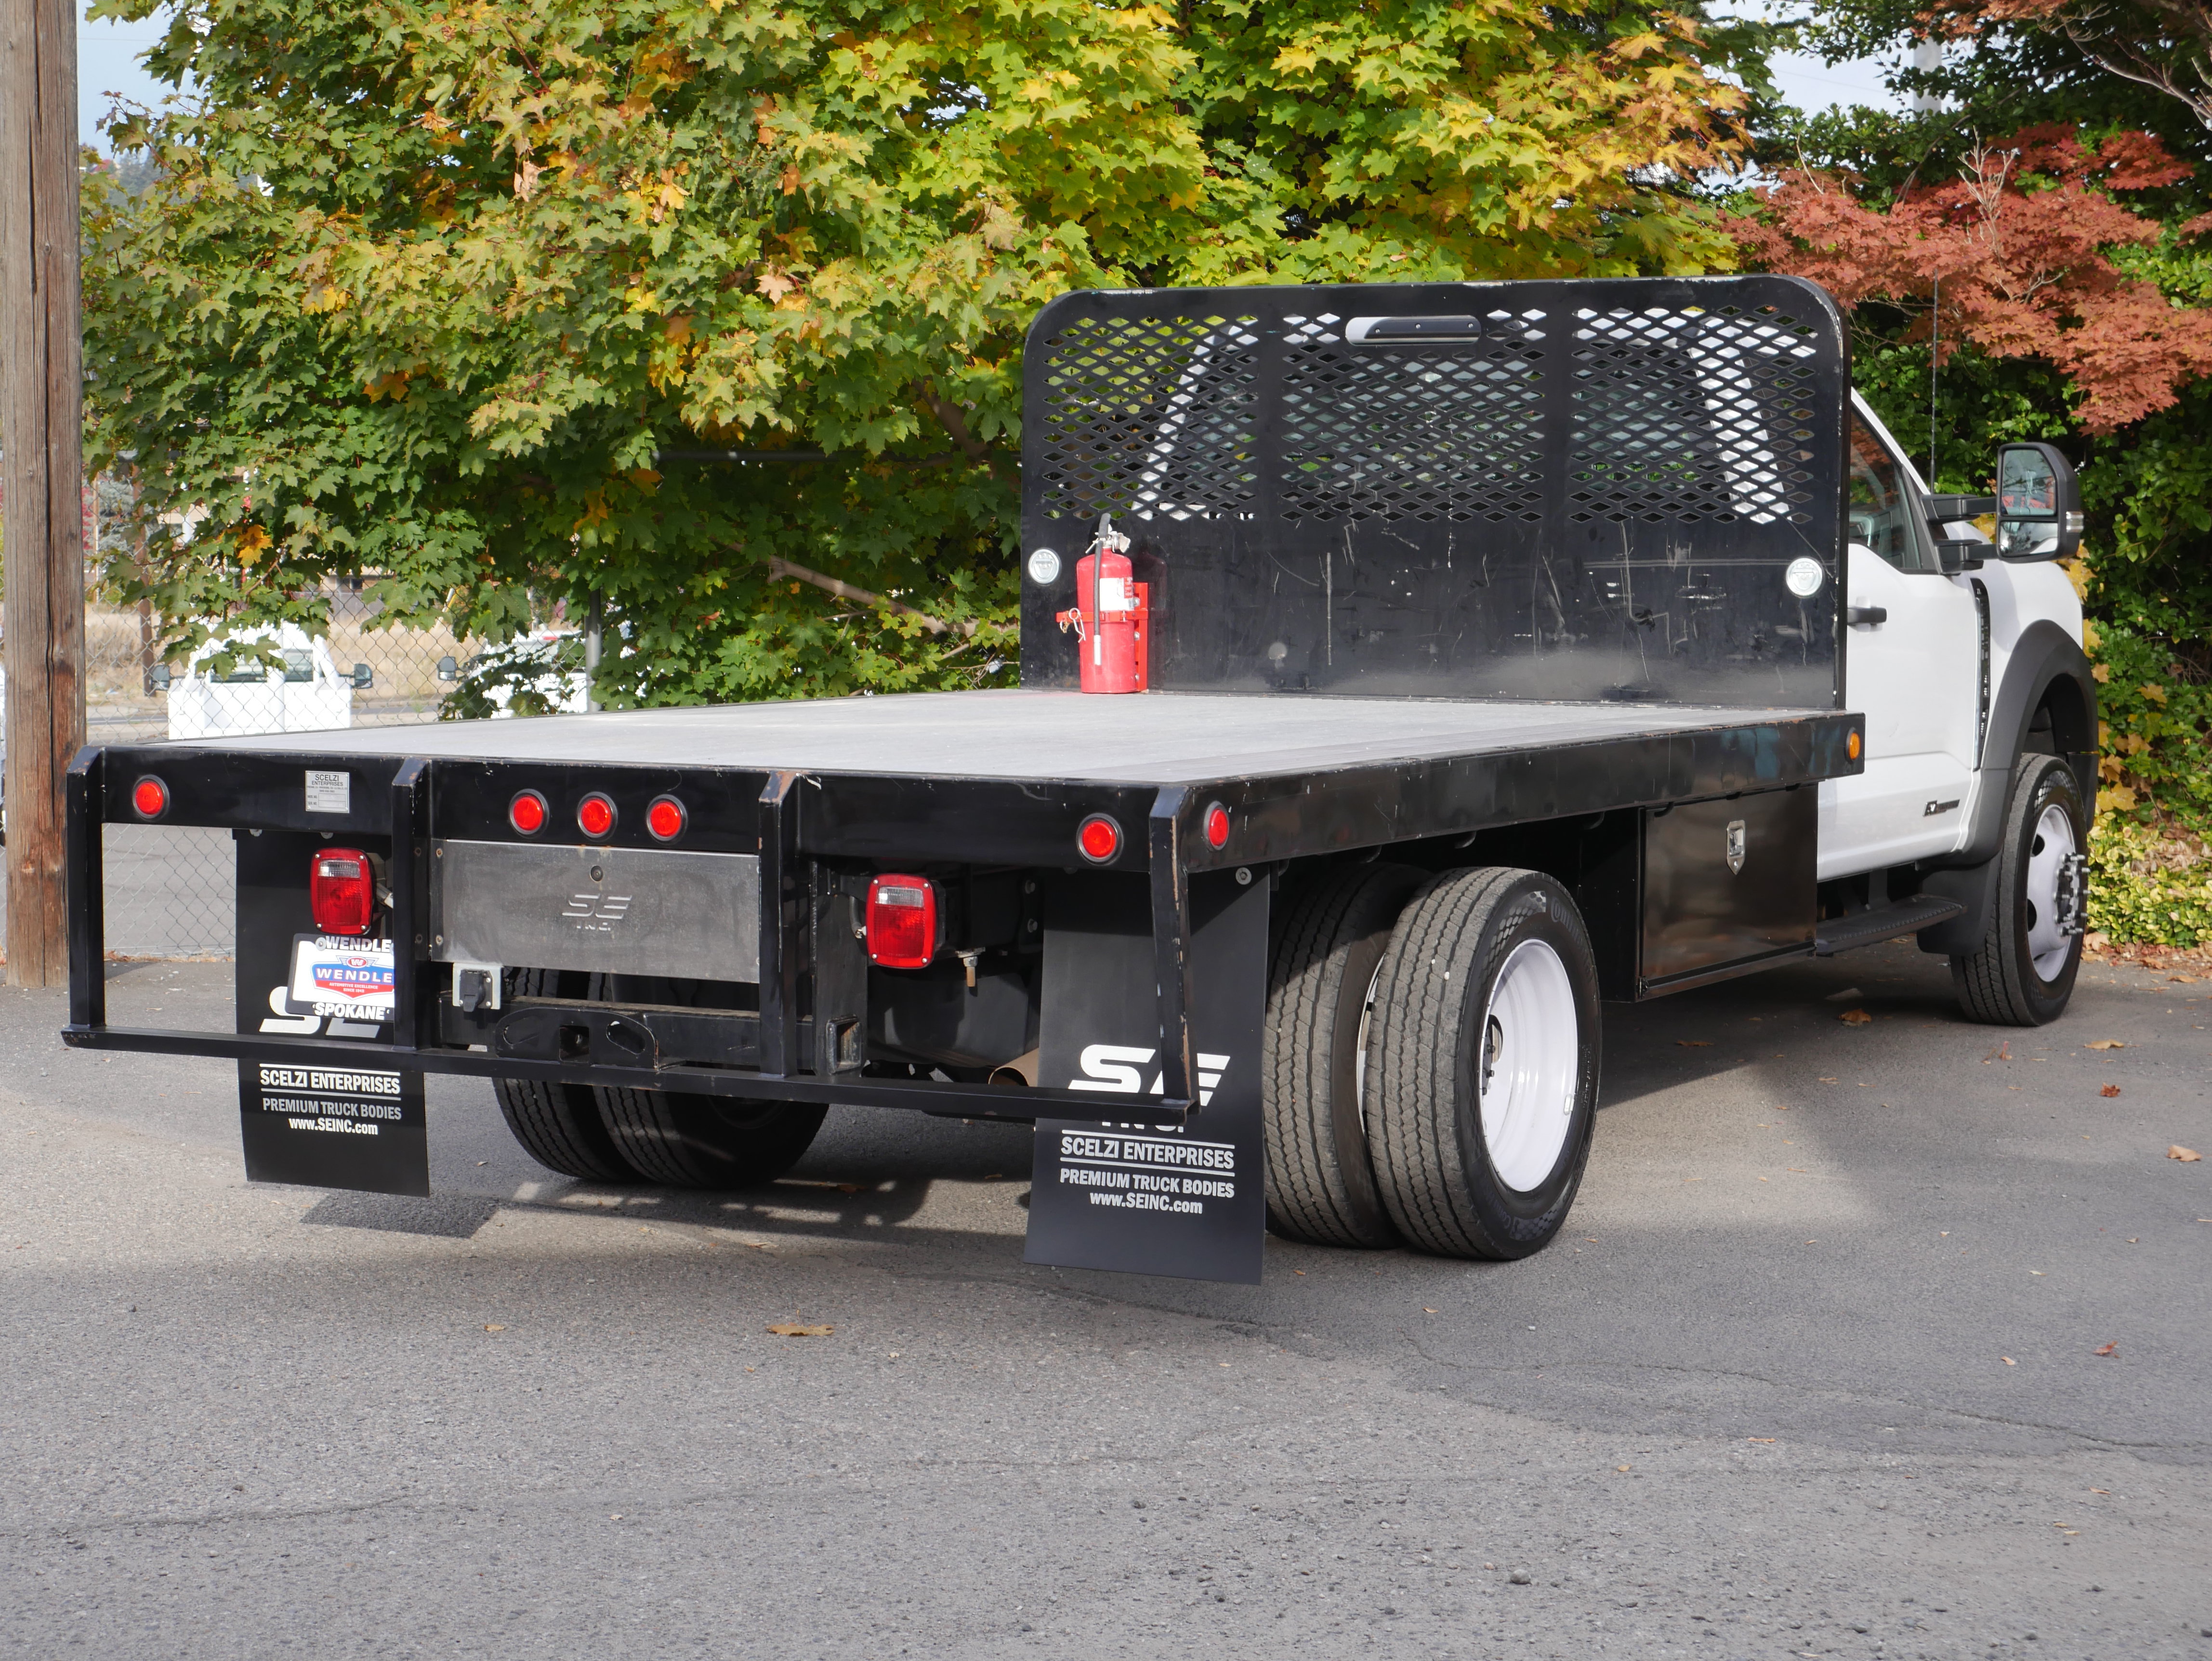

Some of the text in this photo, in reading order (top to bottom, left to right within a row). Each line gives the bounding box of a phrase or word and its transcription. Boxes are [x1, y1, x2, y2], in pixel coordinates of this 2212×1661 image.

[562, 893, 632, 920] SE
[325, 936, 392, 952] WENDLE
[316, 968, 393, 983] WENDLE
[314, 1002, 385, 1020] SPOKANE
[260, 1069, 400, 1094] SCELZI ENTERPRISES
[263, 1097, 402, 1120] PREMIUM TRUCK BODIES
[288, 1117, 379, 1135] www.SEINC.com
[1061, 1136, 1234, 1169] SCELZI ENTERPRISES
[1060, 1168, 1235, 1198] PREMIUM TRUCK BODIES
[1090, 1192, 1202, 1214] www.SEINC.com
